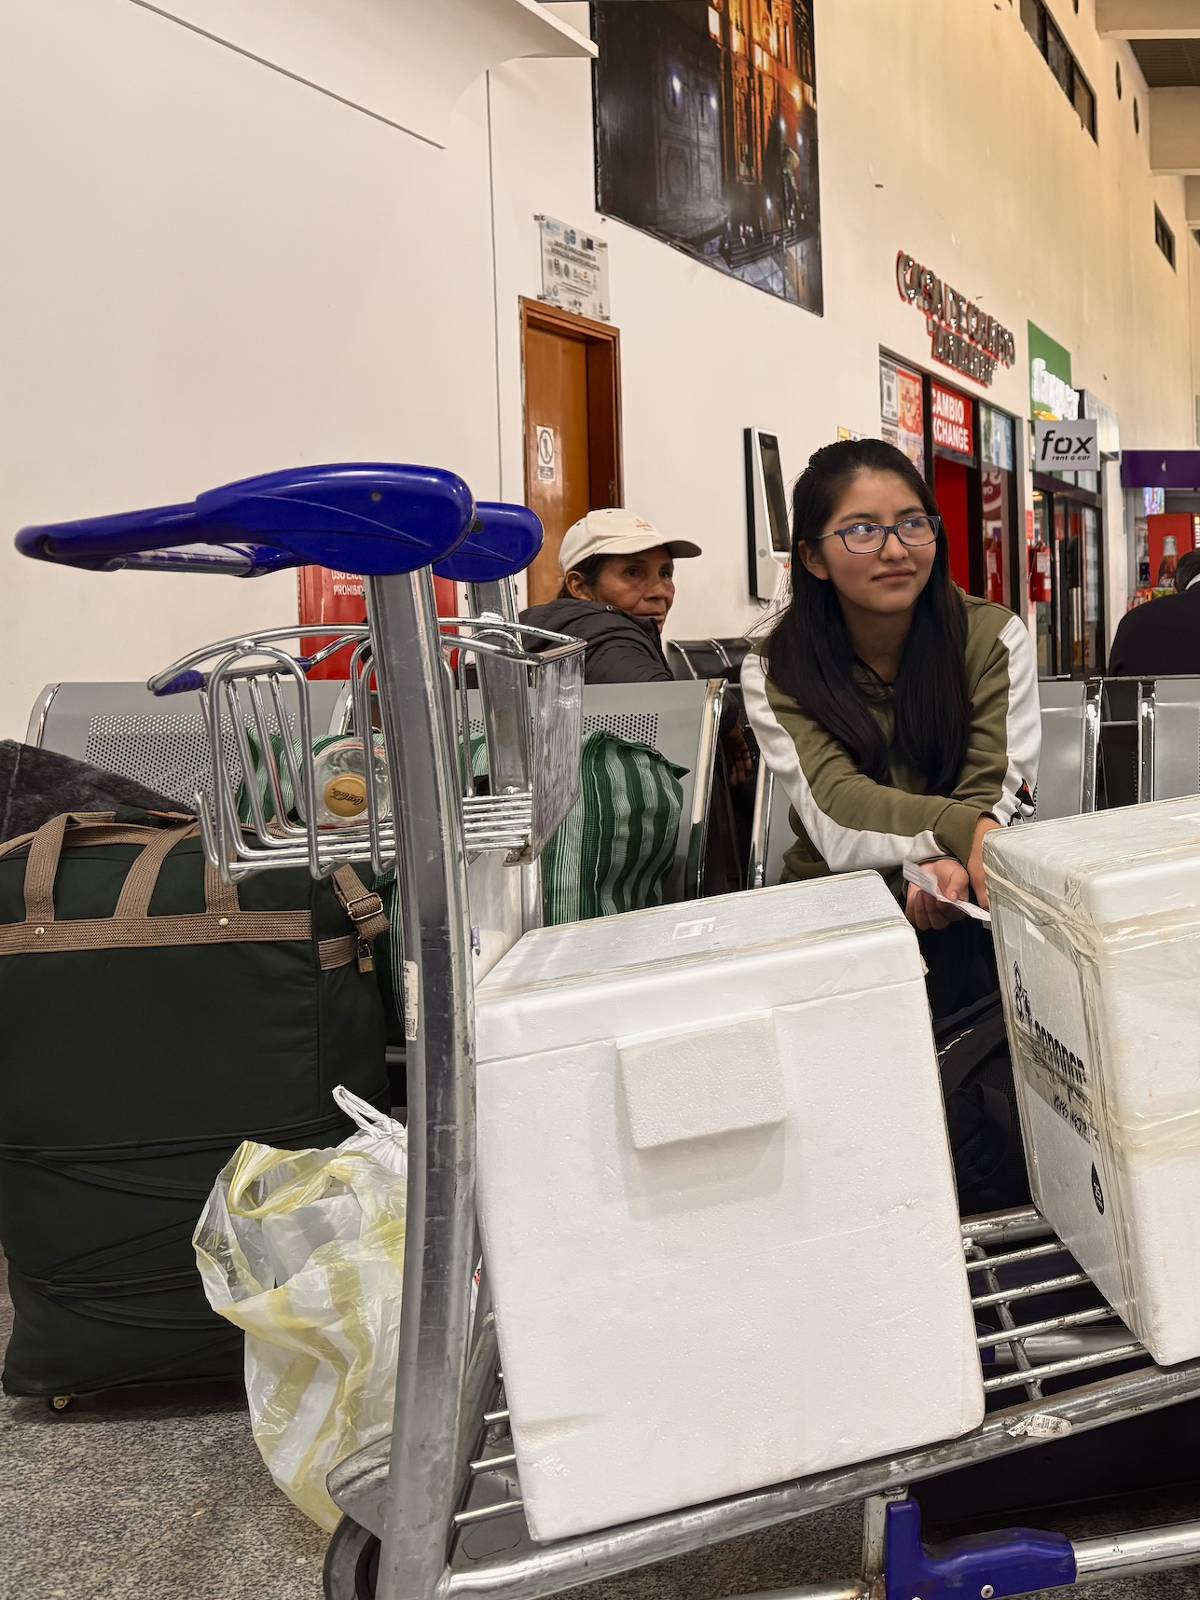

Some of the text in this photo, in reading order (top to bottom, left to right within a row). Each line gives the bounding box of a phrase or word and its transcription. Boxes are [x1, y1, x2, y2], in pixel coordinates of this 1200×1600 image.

[1041, 429, 1094, 461] fox
[1051, 454, 1069, 462] rent
[333, 584, 364, 596] PROHIBID
